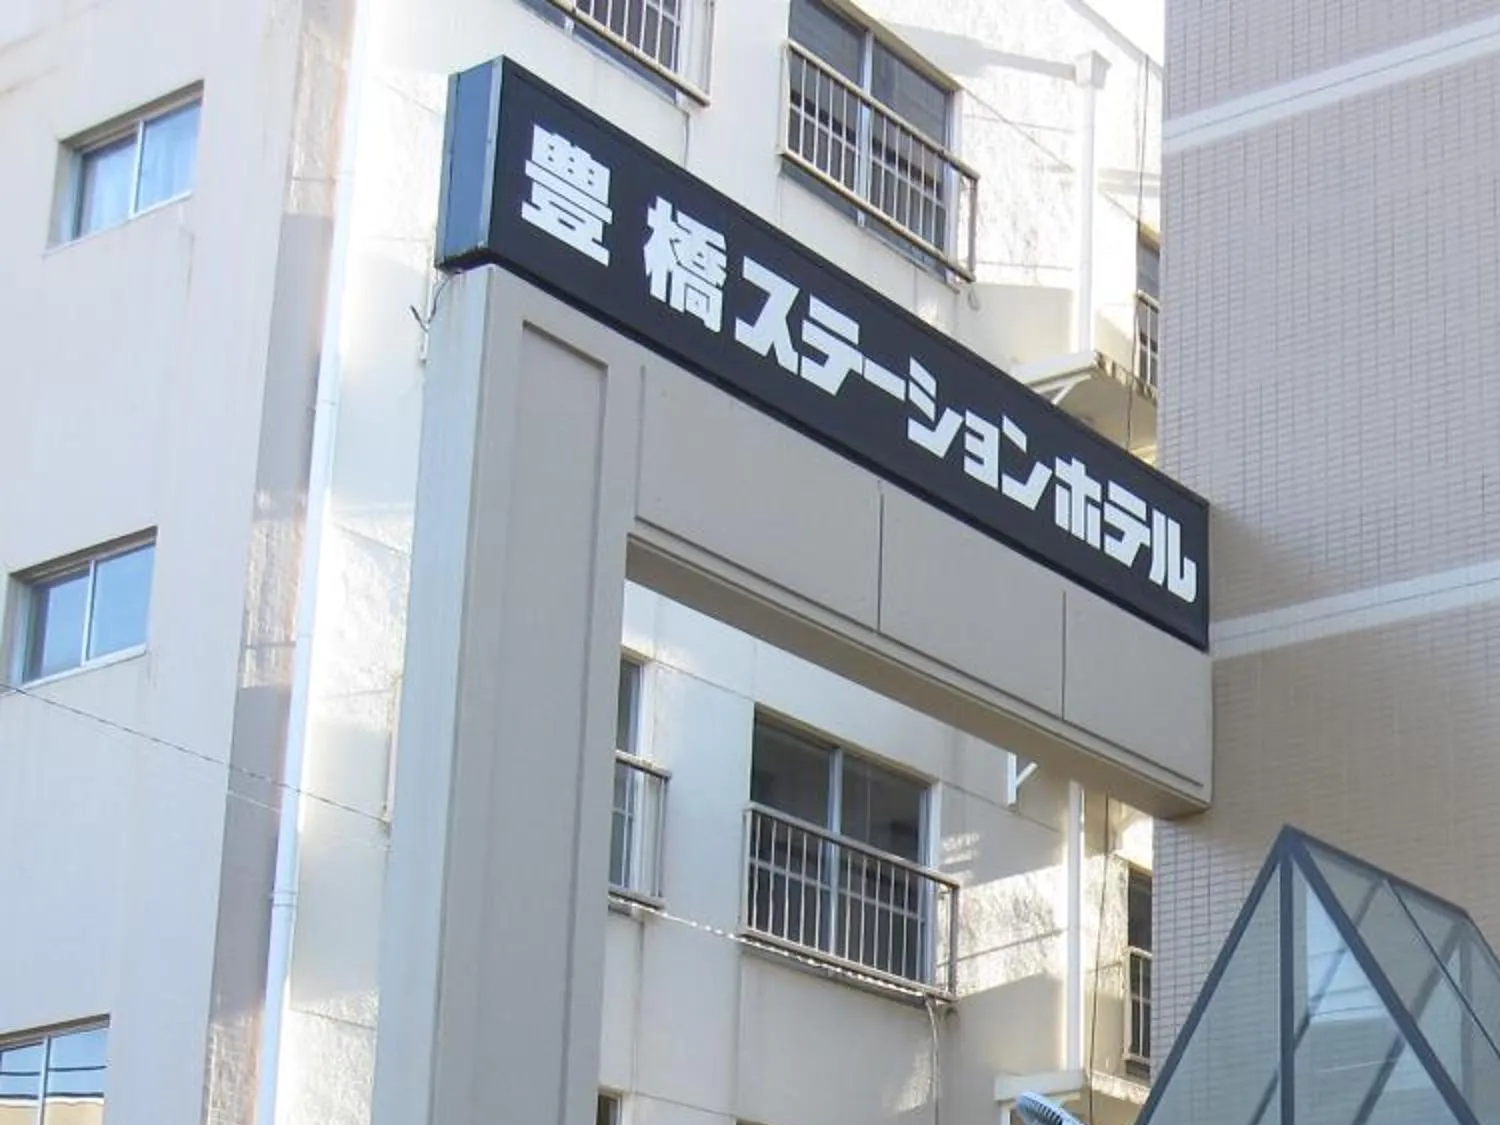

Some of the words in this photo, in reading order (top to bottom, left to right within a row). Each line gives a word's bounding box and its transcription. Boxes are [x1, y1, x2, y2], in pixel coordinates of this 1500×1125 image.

[521, 124, 1198, 604] 豊橋ステーションホテル
